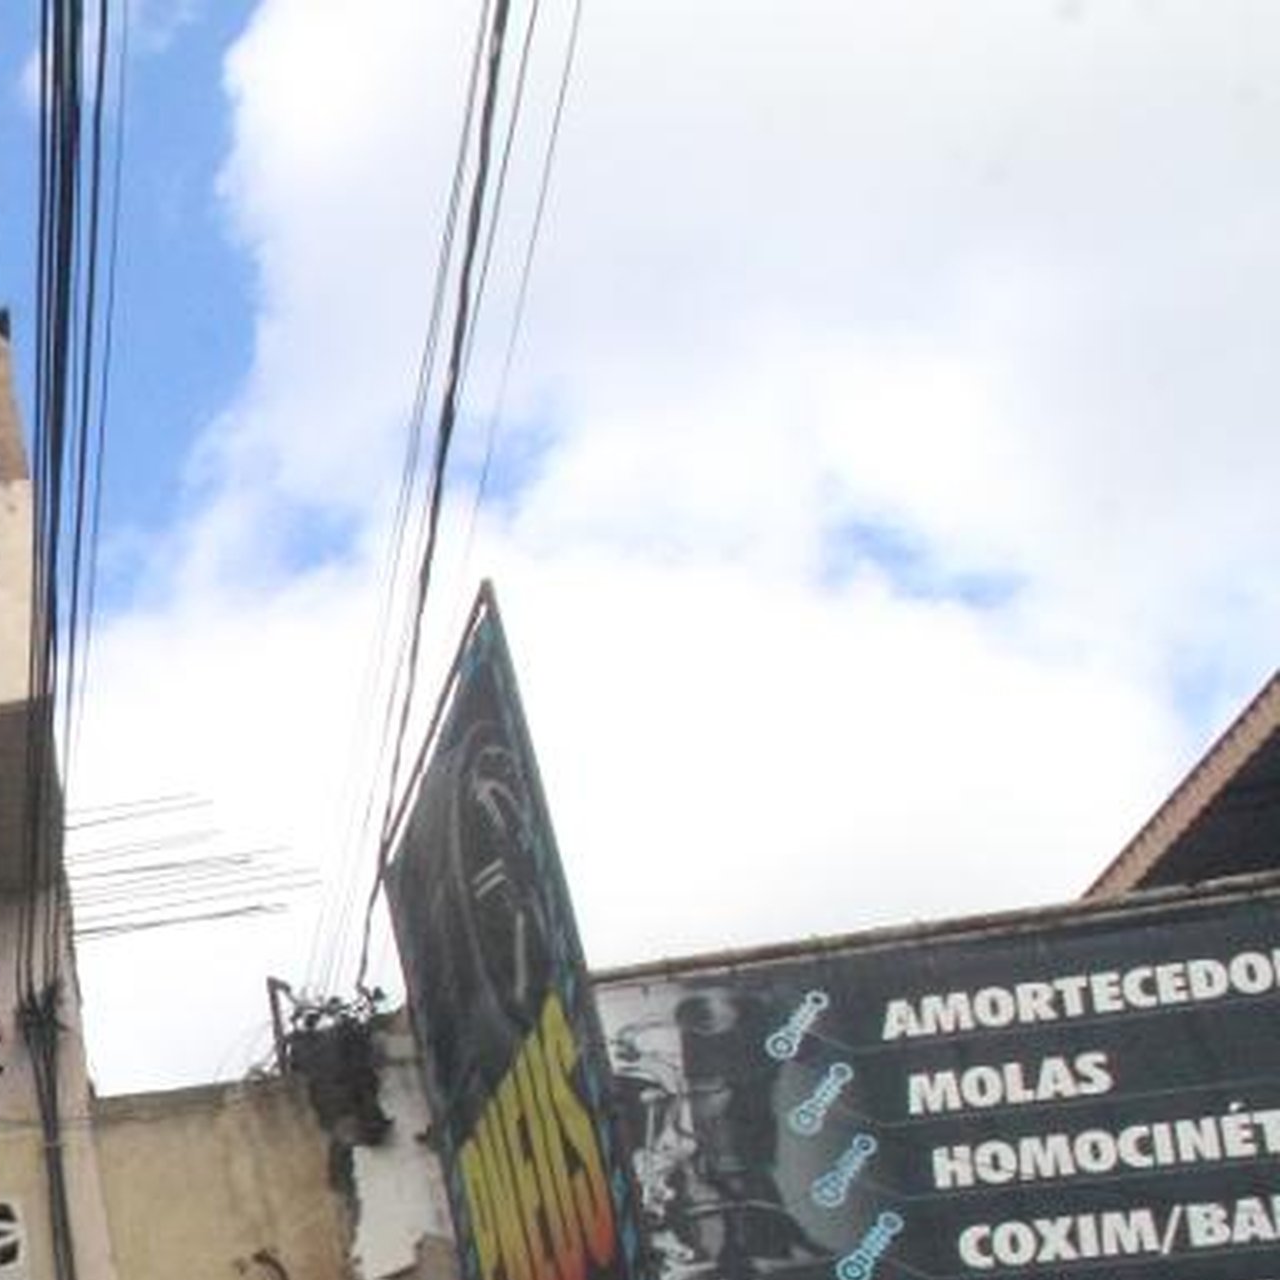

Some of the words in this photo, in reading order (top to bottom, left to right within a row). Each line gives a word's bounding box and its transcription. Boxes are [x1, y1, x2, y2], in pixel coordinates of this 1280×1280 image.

[882, 949, 1280, 1041] AMORTECEDO
[908, 1052, 1114, 1114] MOLAS
[958, 1195, 1280, 1269] COXIM/BA
